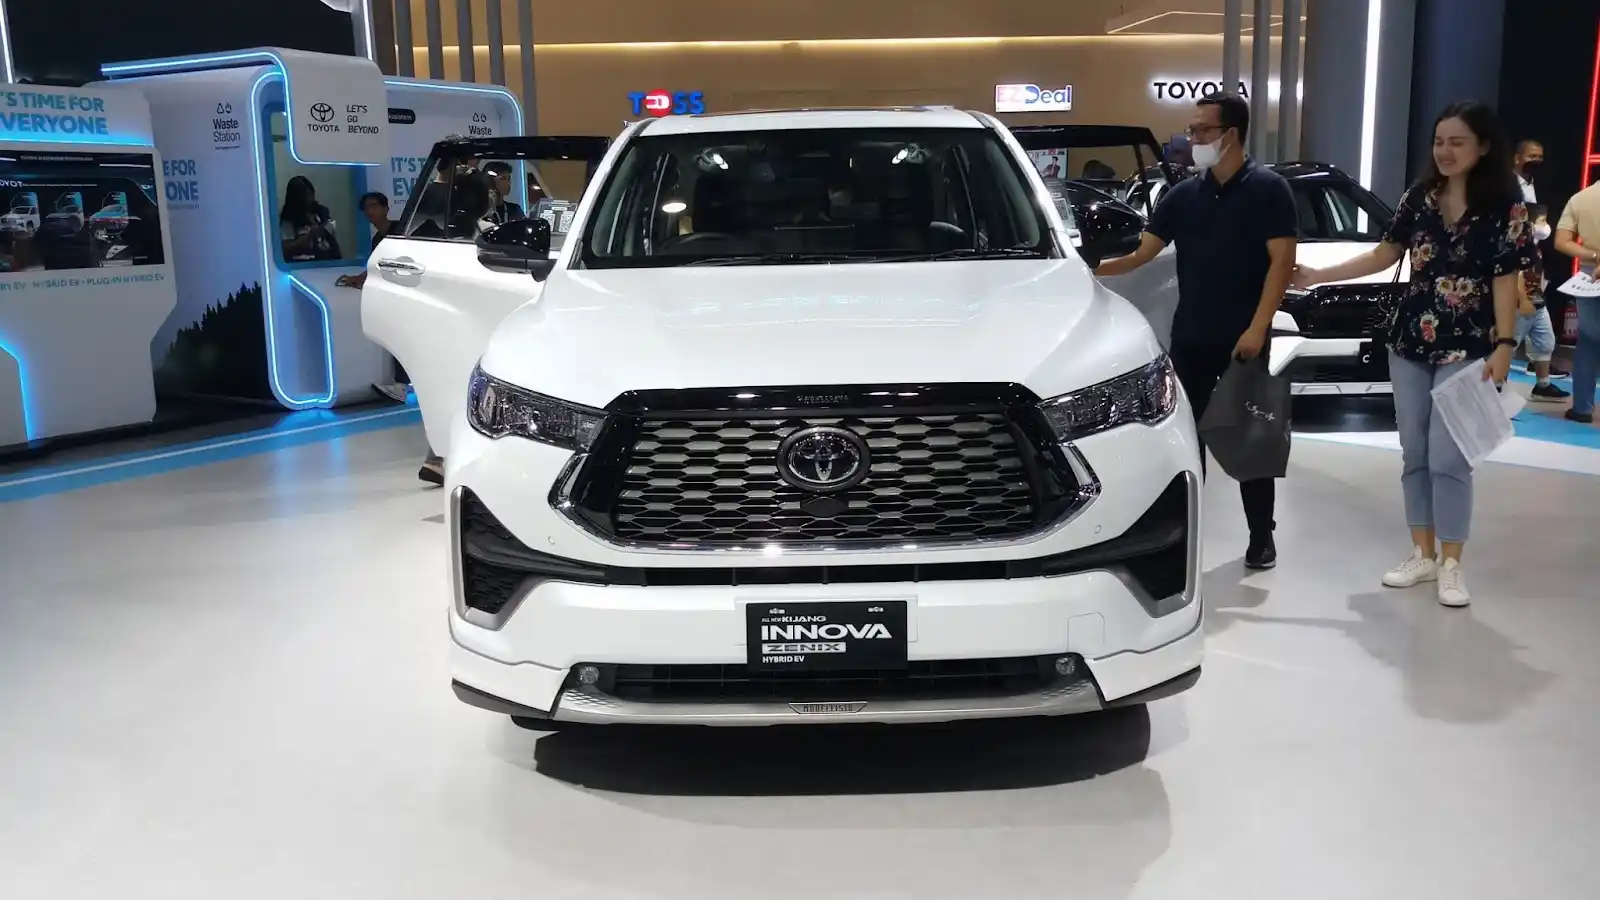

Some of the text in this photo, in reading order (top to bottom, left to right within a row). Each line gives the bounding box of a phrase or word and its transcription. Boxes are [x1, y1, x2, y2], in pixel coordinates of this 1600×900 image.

[1153, 82, 1249, 99] TOYOA
[20, 92, 66, 109] TIME
[69, 94, 105, 112] FOR
[346, 104, 368, 113] LET'S
[347, 115, 358, 123] GO
[213, 118, 240, 130] Waste
[308, 124, 340, 132] TOYOTA
[348, 125, 379, 134] BEYOND
[468, 125, 492, 135] Waste
[213, 131, 241, 142] Station
[171, 160, 196, 176] FOR
[782, 615, 827, 623] KIJANG
[761, 623, 892, 640] INNOVA
[767, 643, 841, 652] ZENIX
[762, 655, 805, 664] HYBRID EV
